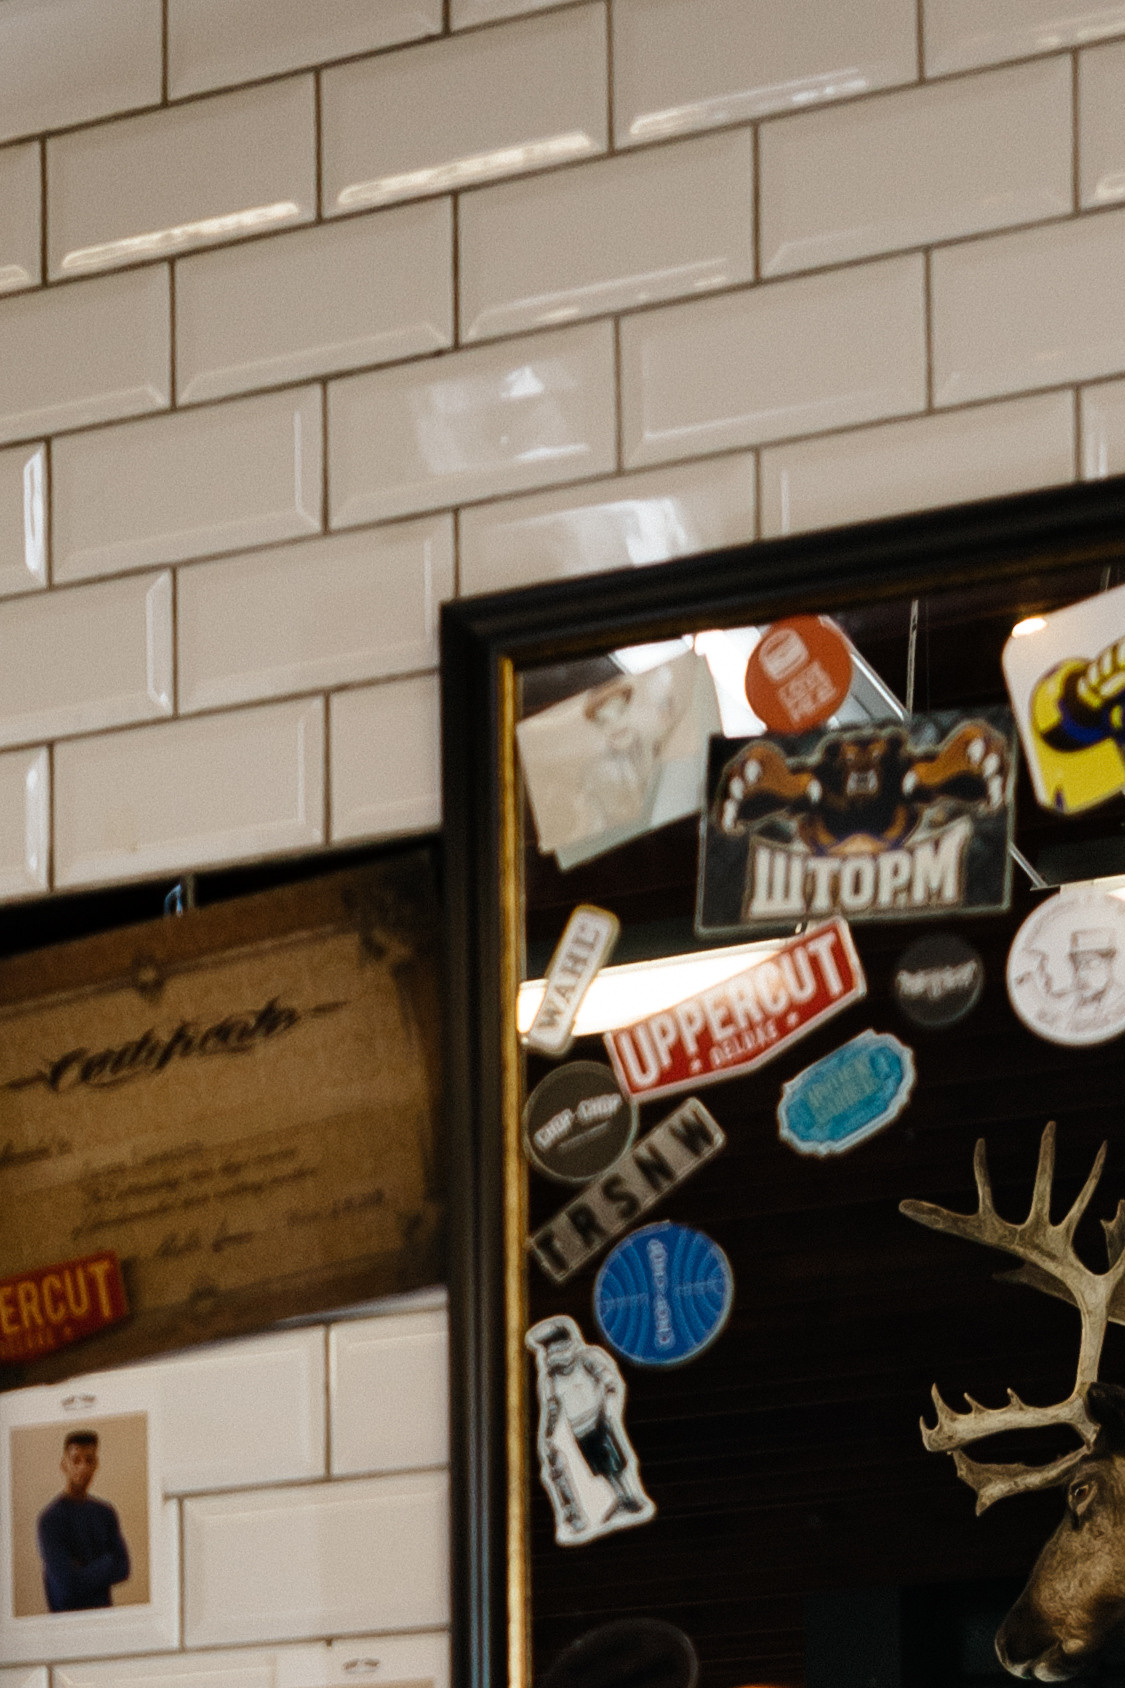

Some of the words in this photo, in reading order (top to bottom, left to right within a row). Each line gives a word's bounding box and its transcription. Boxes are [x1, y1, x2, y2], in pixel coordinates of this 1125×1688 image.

[749, 822, 972, 917] ШТОРМ
[537, 920, 600, 1030] WAHL
[616, 932, 845, 1088] UPPERCUT
